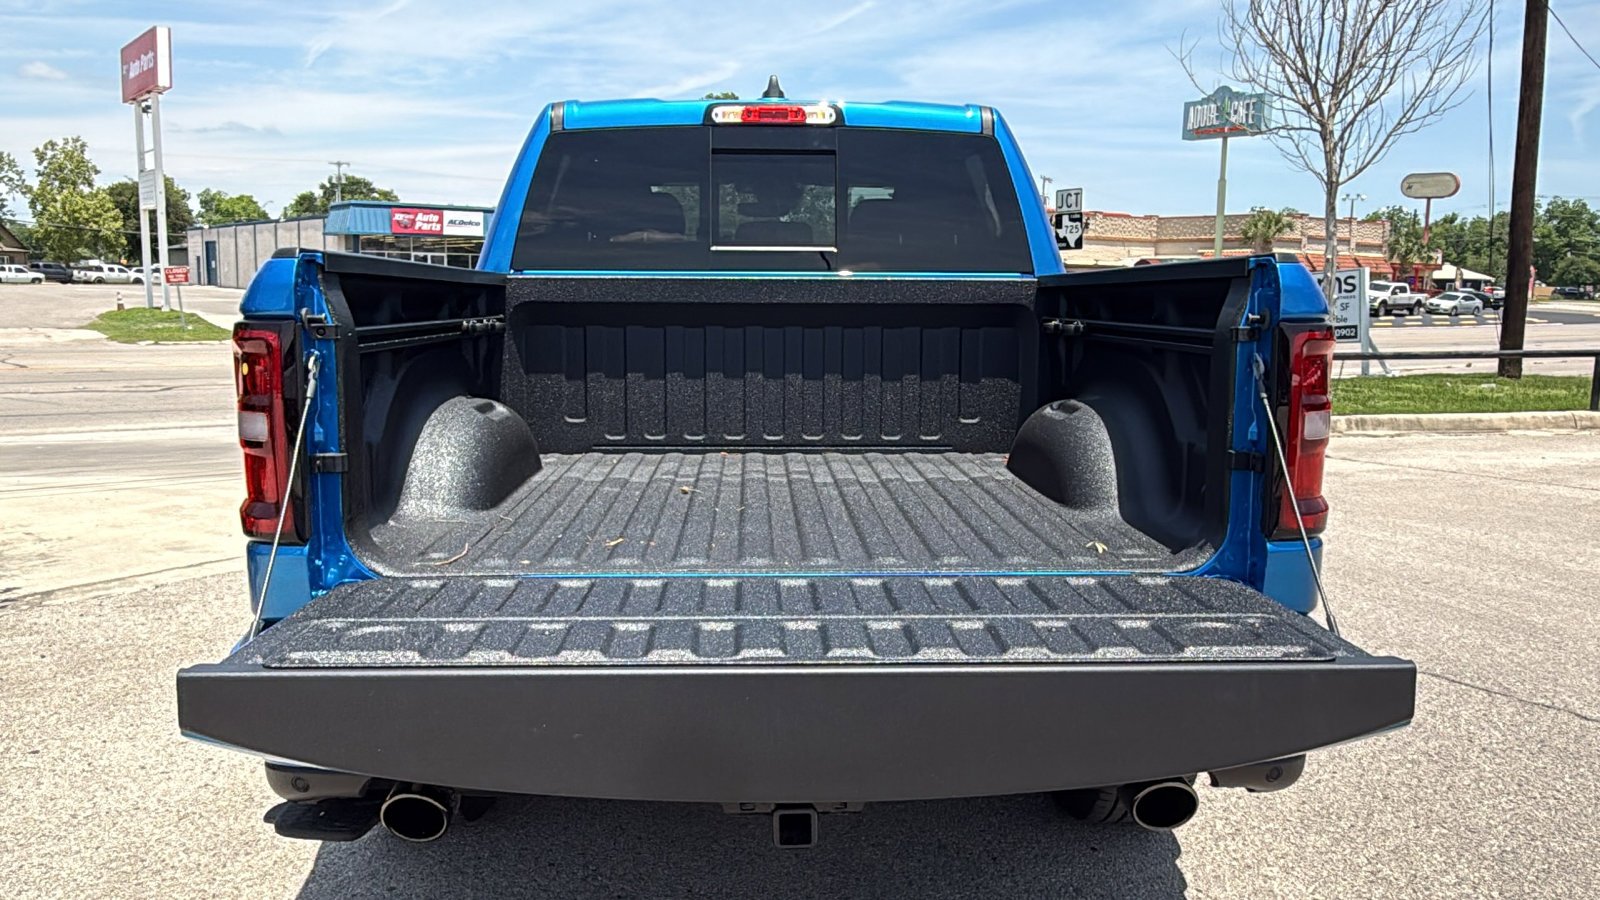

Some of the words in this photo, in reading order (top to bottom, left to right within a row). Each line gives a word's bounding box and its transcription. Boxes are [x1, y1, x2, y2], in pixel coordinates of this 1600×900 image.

[1231, 98, 1257, 124] CAFE
[1057, 192, 1080, 209] JCT
[415, 212, 440, 222] Auto
[414, 222, 442, 231] Parts
[447, 219, 481, 227] ACDelco
[1064, 224, 1080, 234] 725
[1340, 302, 1350, 311] SF
